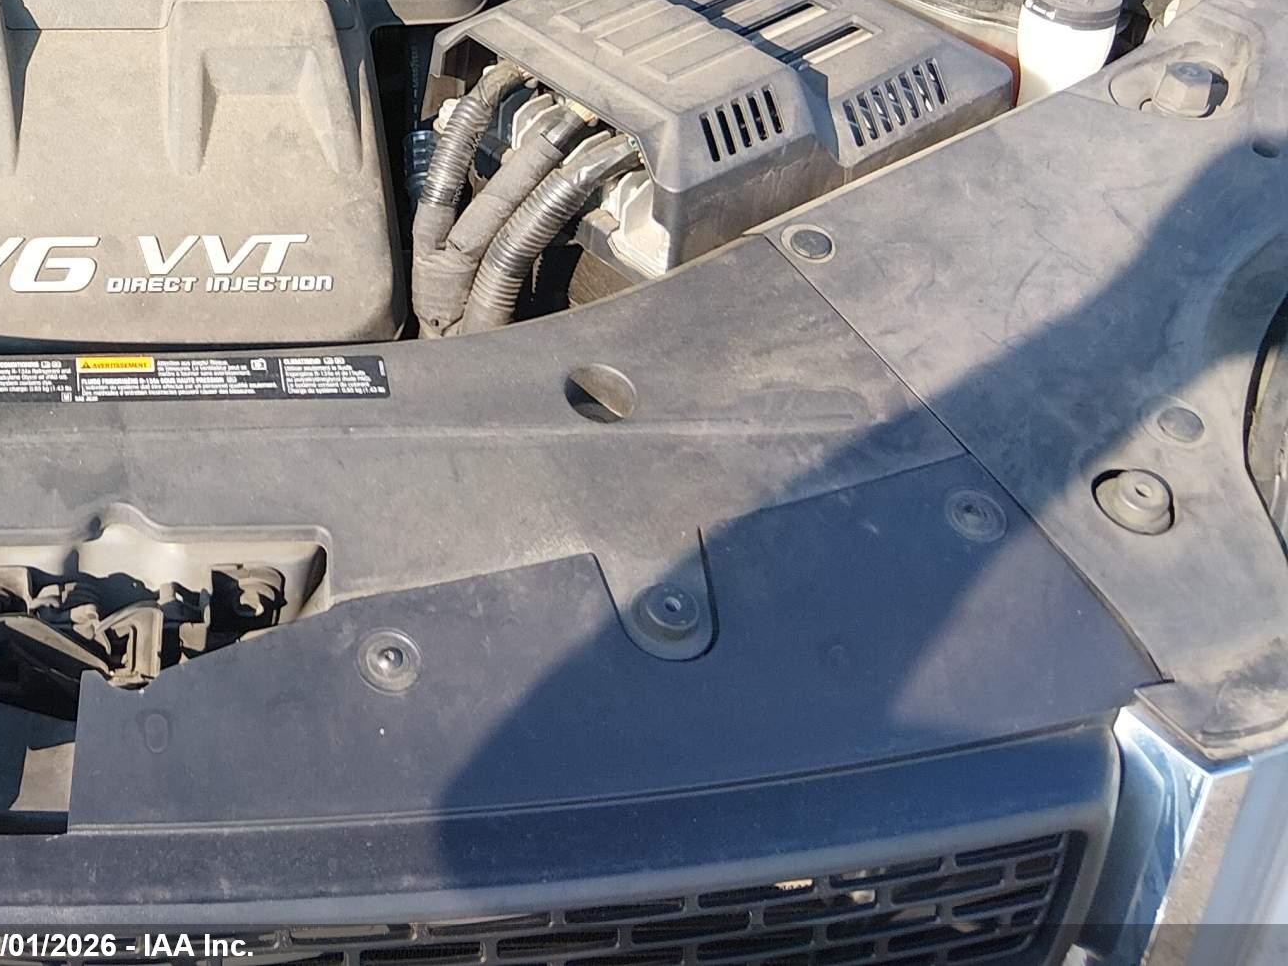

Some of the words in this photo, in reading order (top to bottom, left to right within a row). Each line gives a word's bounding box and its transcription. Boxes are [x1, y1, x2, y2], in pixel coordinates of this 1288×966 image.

[137, 234, 310, 275] VVT
[107, 276, 199, 293] DIRECT
[206, 275, 334, 293] INJECTION
